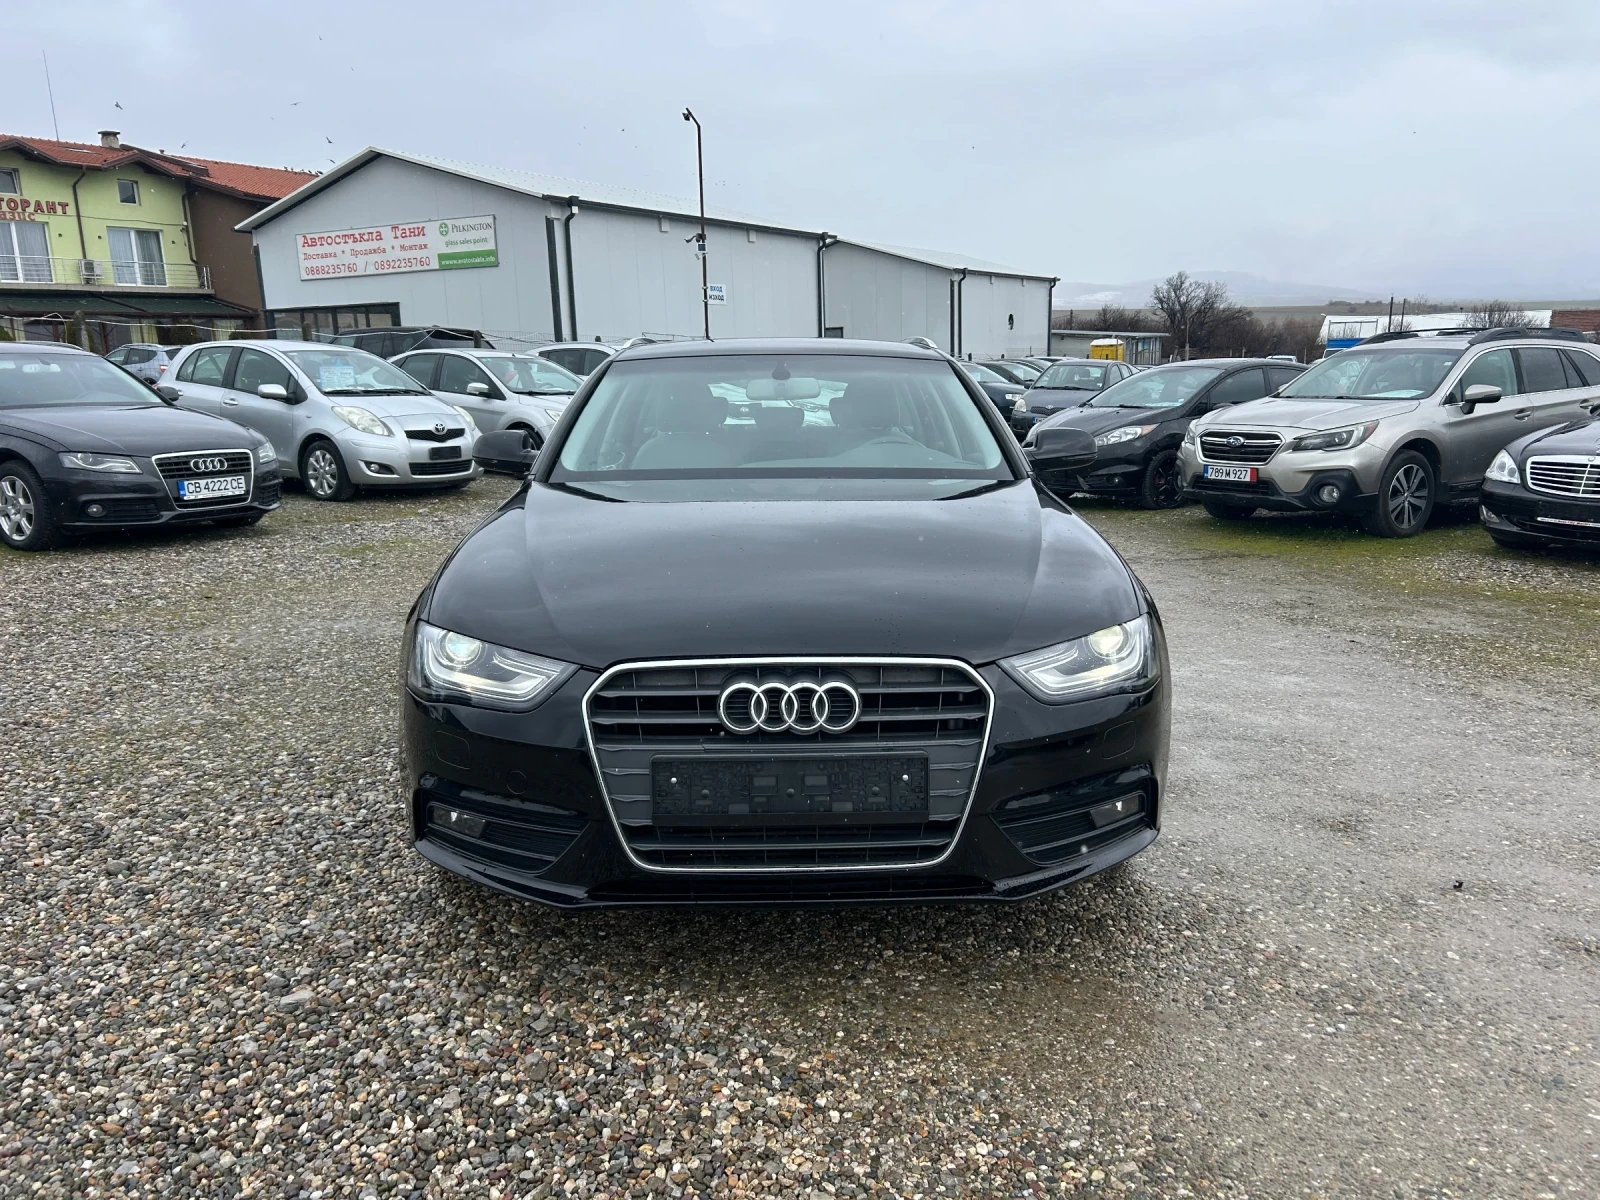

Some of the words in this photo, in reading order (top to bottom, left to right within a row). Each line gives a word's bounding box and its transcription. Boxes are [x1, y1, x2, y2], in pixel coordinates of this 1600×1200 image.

[302, 230, 384, 248] Автостъкла
[391, 225, 426, 239] Тани
[445, 240, 458, 248] glass
[473, 237, 488, 246] point
[303, 251, 337, 261] Доставка
[350, 246, 386, 258] Продажба
[400, 243, 428, 252] Монтаж
[305, 262, 358, 276] 0888235760
[373, 256, 431, 271] 0892235760
[1209, 467, 1224, 478] 789
[1232, 469, 1248, 479] 927
[186, 481, 202, 494] CB
[203, 480, 229, 492] 4222
[230, 478, 244, 490] CE
